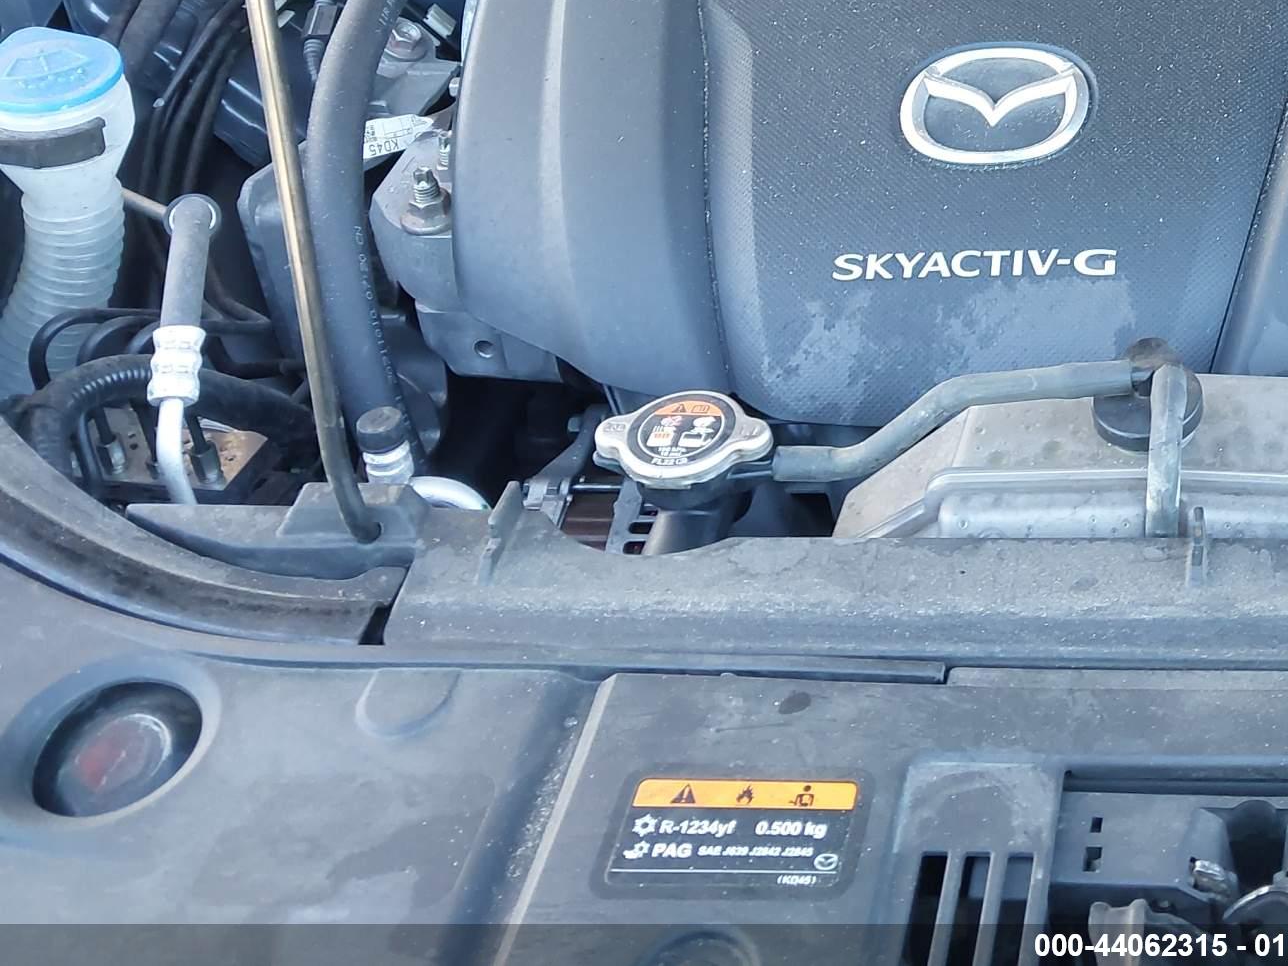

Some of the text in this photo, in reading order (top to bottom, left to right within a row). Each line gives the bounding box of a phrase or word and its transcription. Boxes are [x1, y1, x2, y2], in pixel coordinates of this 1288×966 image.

[368, 138, 400, 156] KD45
[831, 248, 1118, 281] SKYACTIV-G
[659, 820, 828, 839] R-1234yf 0.500 kg
[652, 843, 692, 859] PAG
[697, 845, 722, 856] SAE
